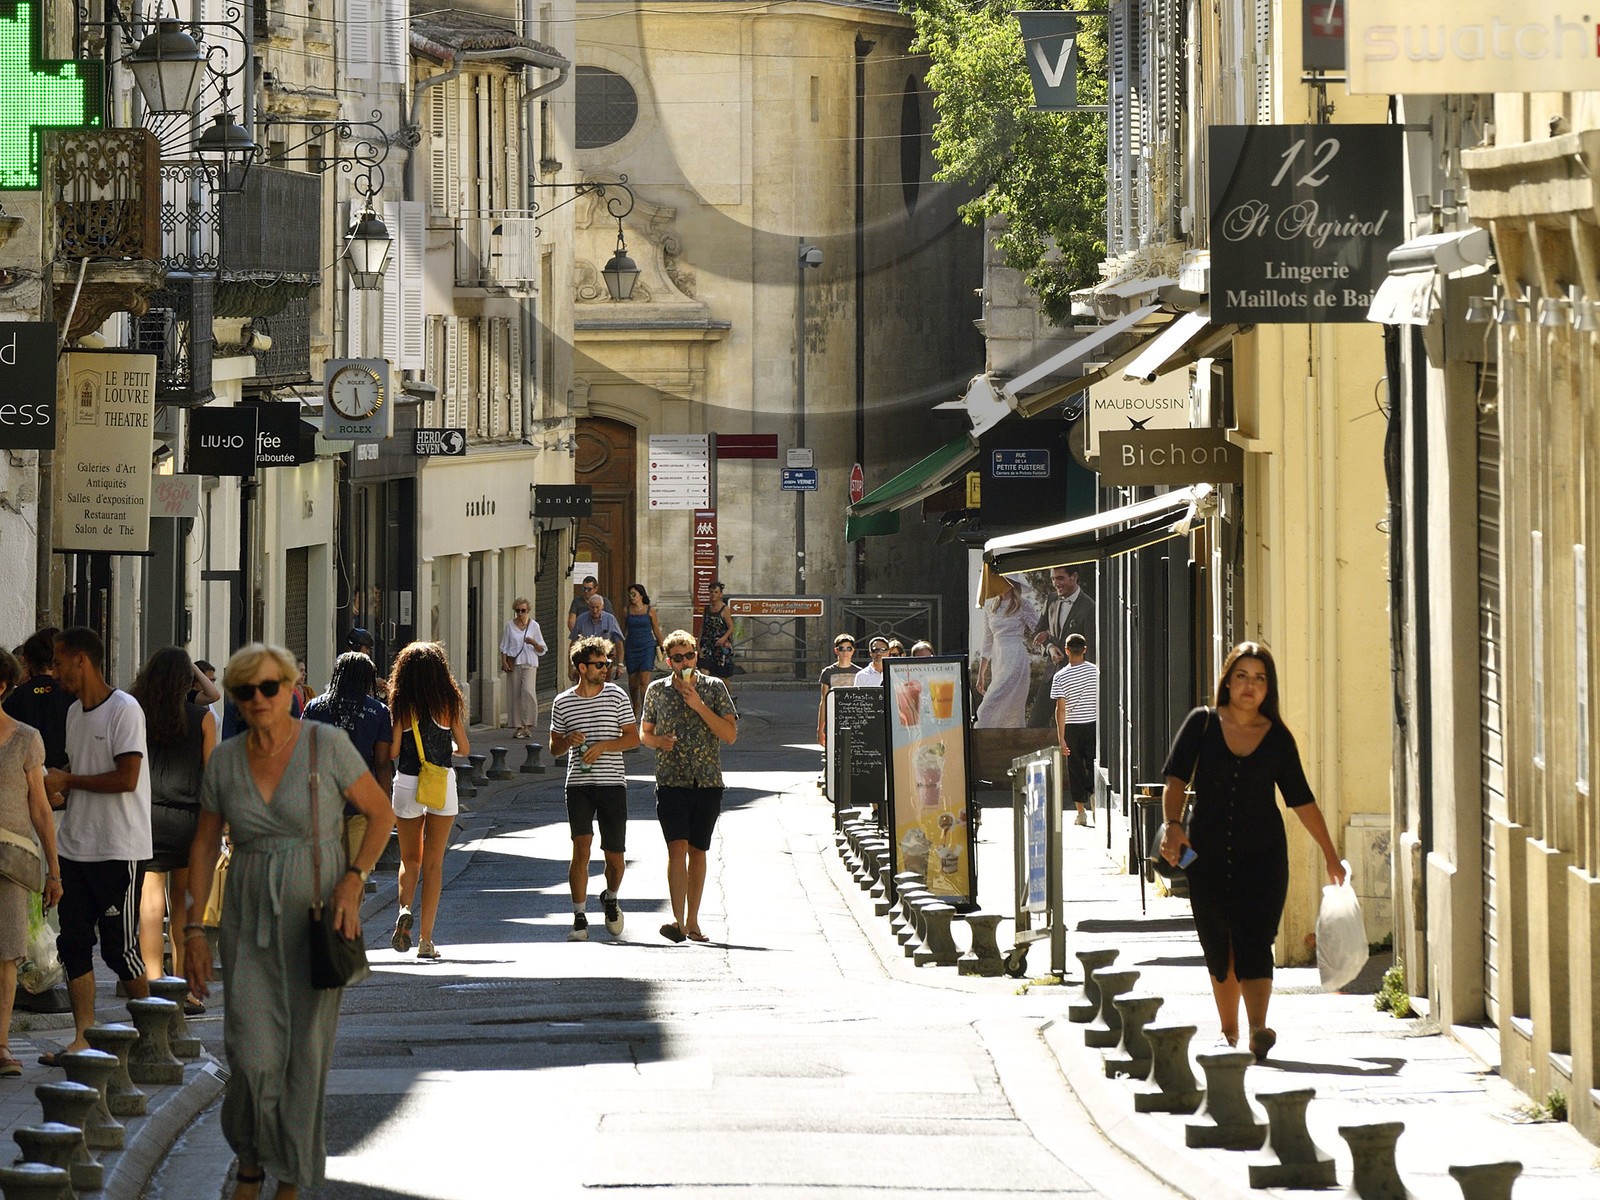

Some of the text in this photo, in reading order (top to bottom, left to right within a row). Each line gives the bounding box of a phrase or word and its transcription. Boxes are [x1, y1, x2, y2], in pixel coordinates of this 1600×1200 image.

[1363, 15, 1589, 62] swatch
[1031, 39, 1074, 87] V
[1271, 138, 1340, 187] 12
[1223, 200, 1389, 249] St Agricol
[1265, 262, 1349, 283] Lingerie
[1226, 289, 1374, 308] Maillots de Bai
[106, 371, 150, 386] LE PETIT
[105, 389, 148, 403] LOUVRE
[1095, 399, 1183, 410] MAUBOUSSIN
[105, 412, 148, 427] THEATRE
[417, 431, 440, 443] HERO
[416, 444, 440, 454] SEVEN
[1122, 444, 1227, 466] Bichon
[78, 462, 136, 473] Galeries d'Art
[86, 478, 127, 490] Antiquités
[67, 493, 144, 506] Salles d'exposition
[466, 495, 495, 516] sandro
[84, 510, 126, 520] Restaurant
[75, 524, 134, 535] Salon de Thé
